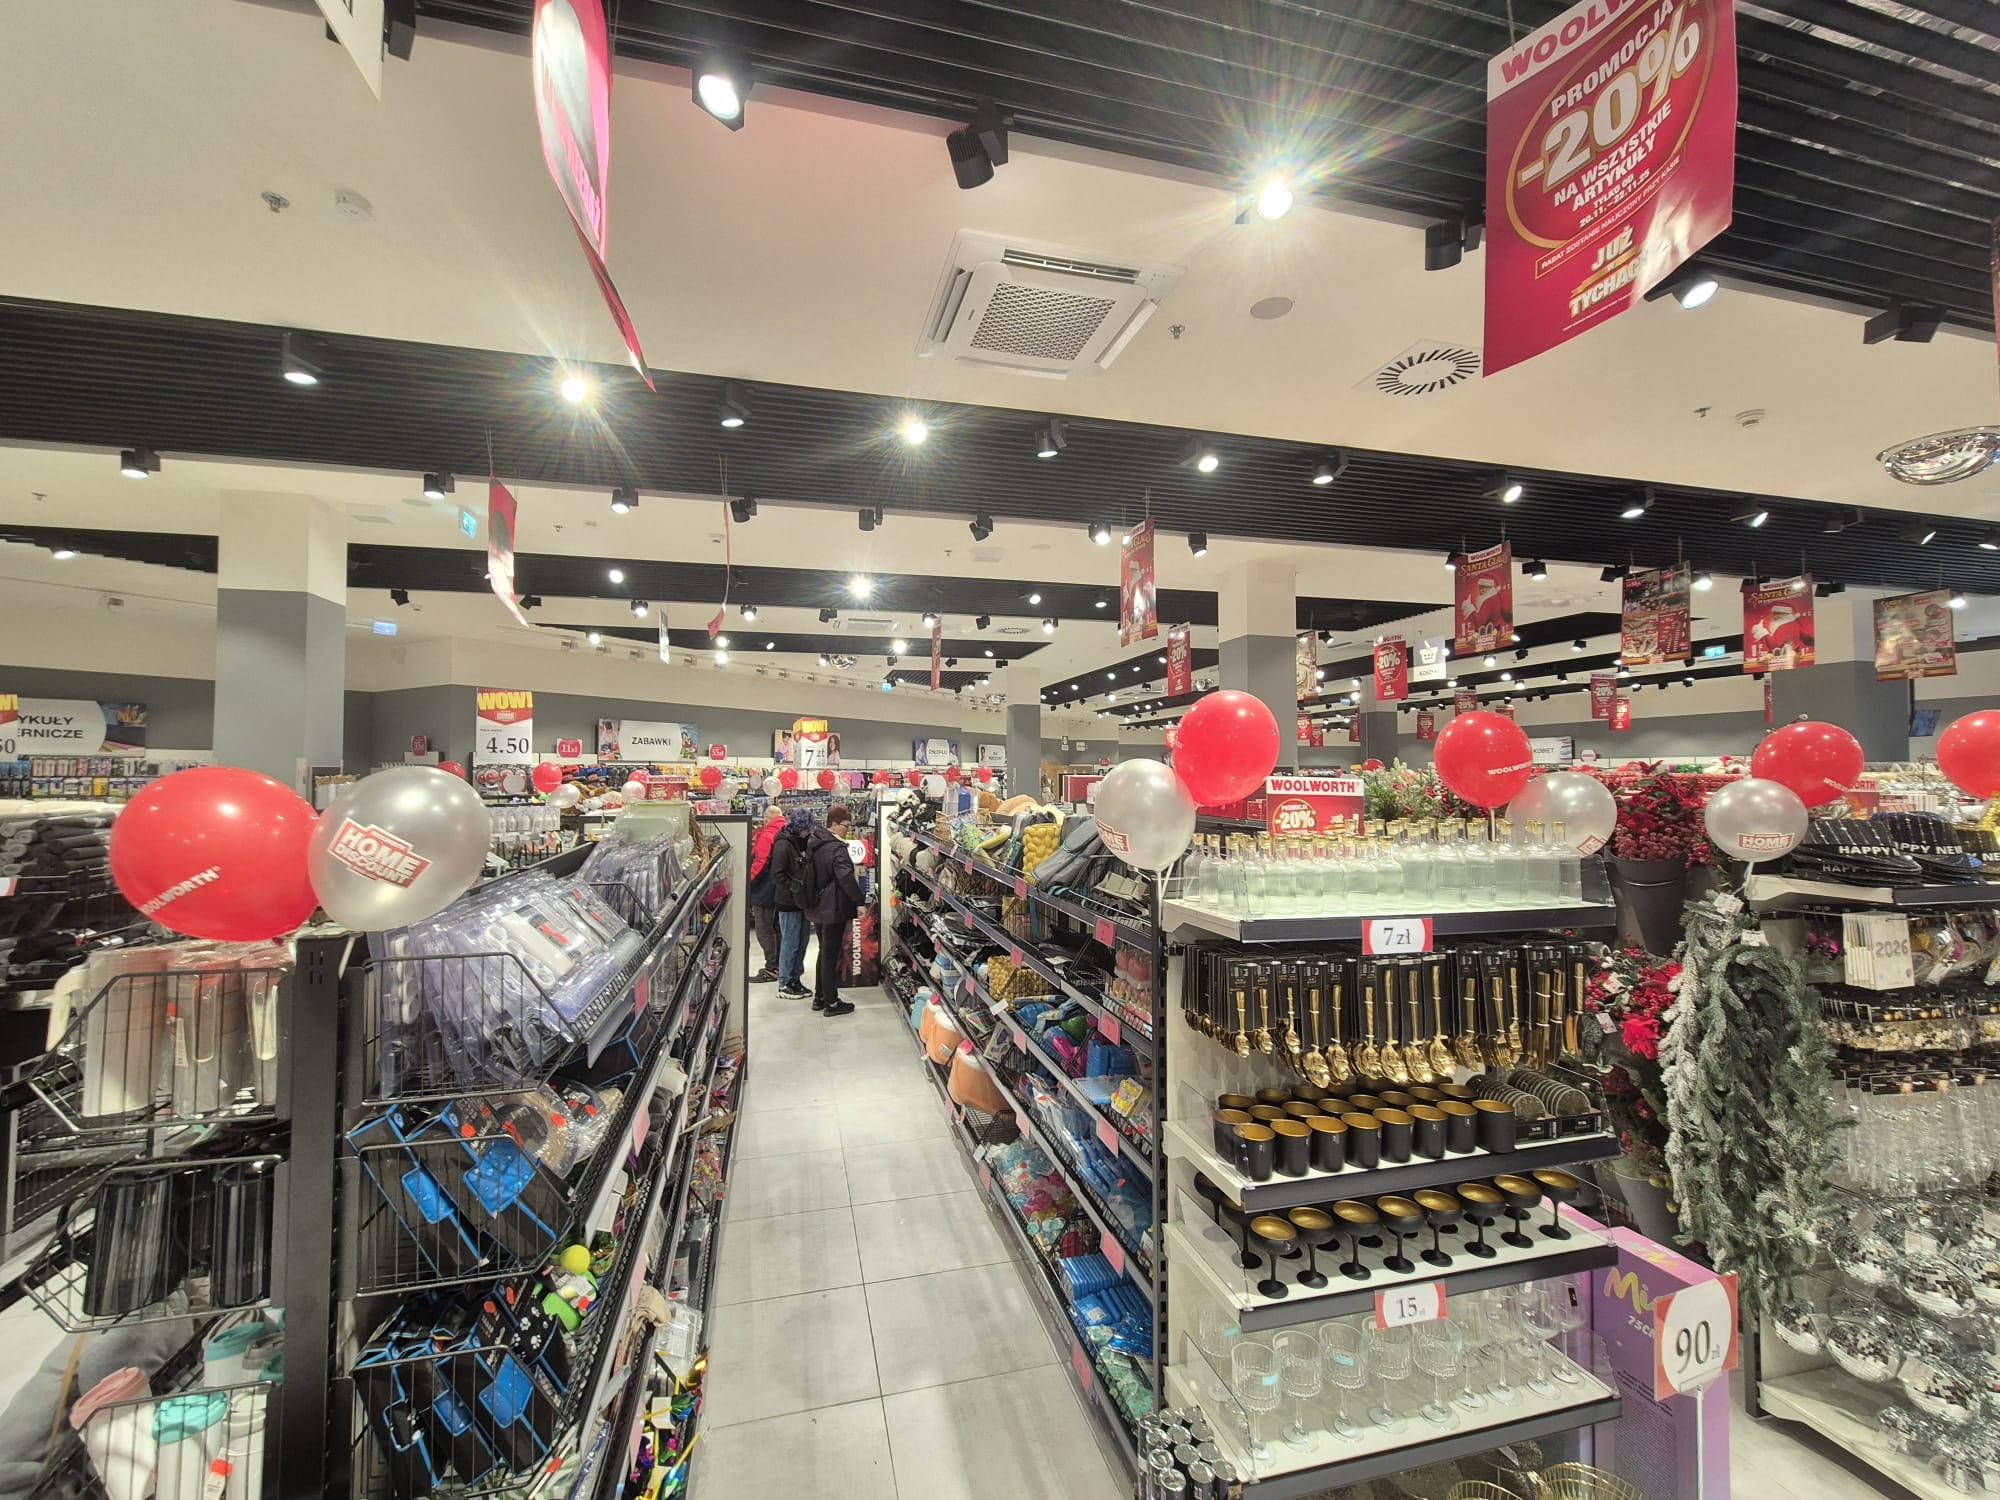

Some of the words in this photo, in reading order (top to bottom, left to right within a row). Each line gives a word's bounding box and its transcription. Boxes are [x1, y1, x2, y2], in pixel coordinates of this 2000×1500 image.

[1551, 1, 1674, 118] PROMOCJA
[1521, 4, 1700, 188] -20%
[1554, 182, 1579, 207] NA
[1581, 99, 1672, 188] WSZYSTKIE
[1572, 132, 1656, 212] ARTYKUŁY
[1593, 185, 1621, 209] TYLKO
[1622, 173, 1634, 188] OD
[1541, 249, 1566, 269] RABAT
[1565, 227, 1601, 255] ZOSTANIE
[1601, 193, 1642, 230] NALICZONY
[1591, 225, 1633, 271] JUŻ
[477, 691, 533, 710] WOW!
[18, 715, 74, 726] YKUŁY
[18, 728, 84, 739] RNICZE
[486, 737, 529, 753] 4.50
[631, 736, 671, 746] ZABAWKI
[1270, 778, 1356, 793] WOOLWORTH
[1274, 810, 1316, 830] -20%
[341, 827, 422, 878] HOME
[1742, 836, 1789, 846] HOME
[1838, 845, 1890, 855] HAPPY
[333, 842, 412, 885] DISCOUNT
[852, 918, 862, 976] WOOLWORT
[1383, 927, 1395, 946] 7
[1396, 928, 1412, 945] zł
[1876, 938, 1909, 958] 2026
[1603, 1266, 1658, 1314] Mi
[1396, 1296, 1418, 1319] 15
[1676, 1320, 1711, 1374] 90
